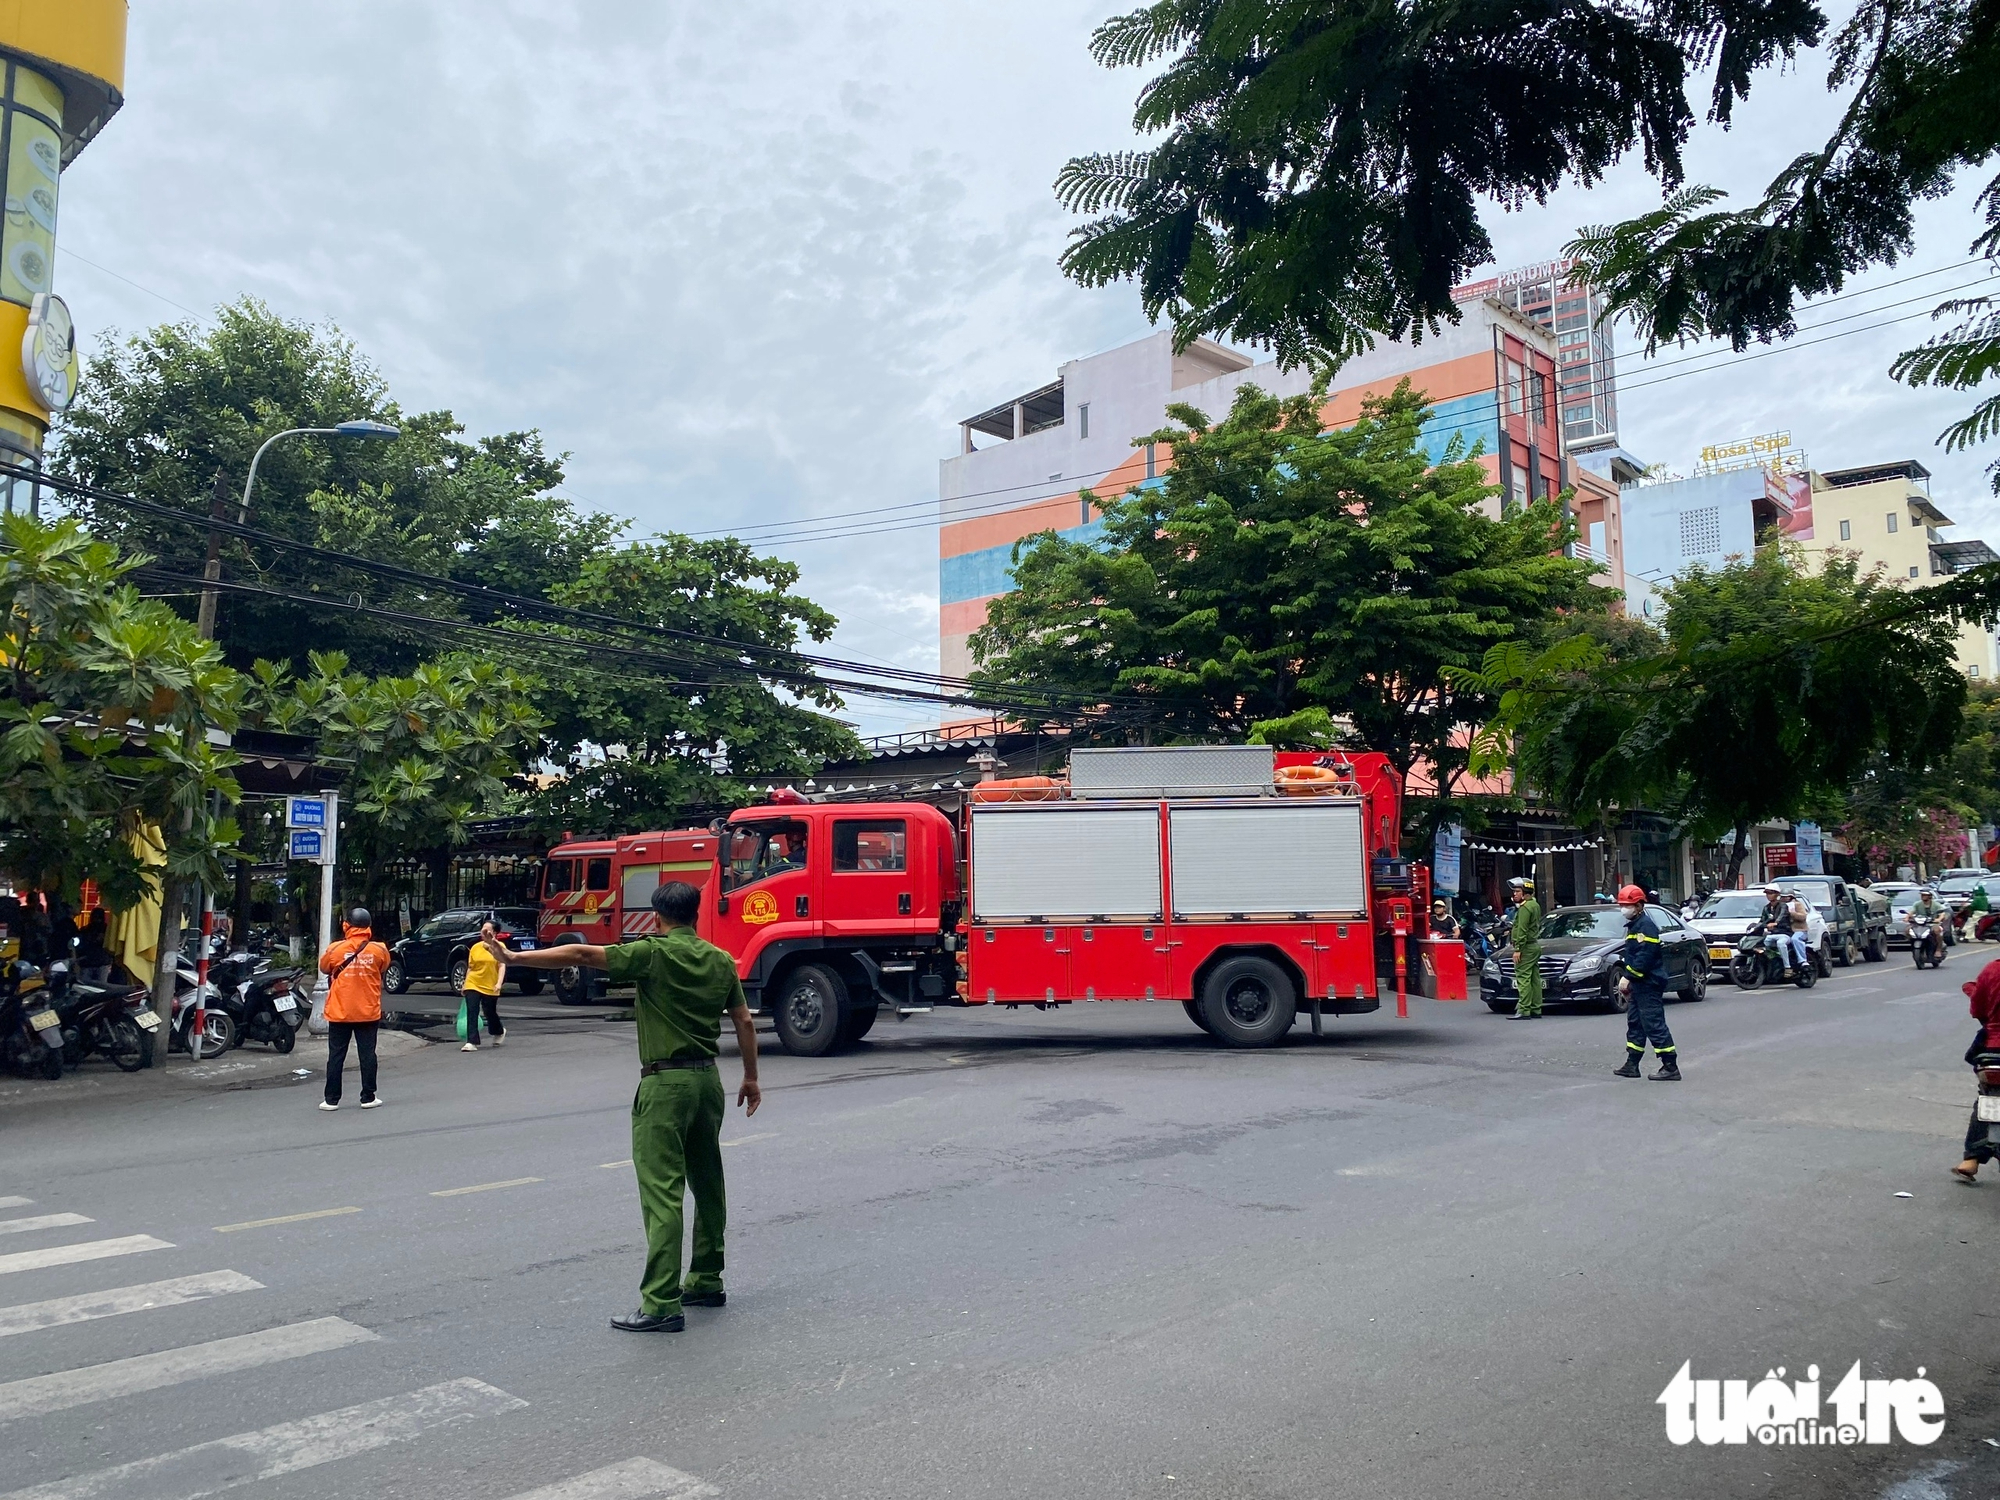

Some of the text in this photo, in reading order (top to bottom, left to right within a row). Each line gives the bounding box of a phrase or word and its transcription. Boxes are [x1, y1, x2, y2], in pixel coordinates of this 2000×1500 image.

[1497, 257, 1564, 288] PANOMA
[1702, 436, 1789, 462] Rosa Spa
